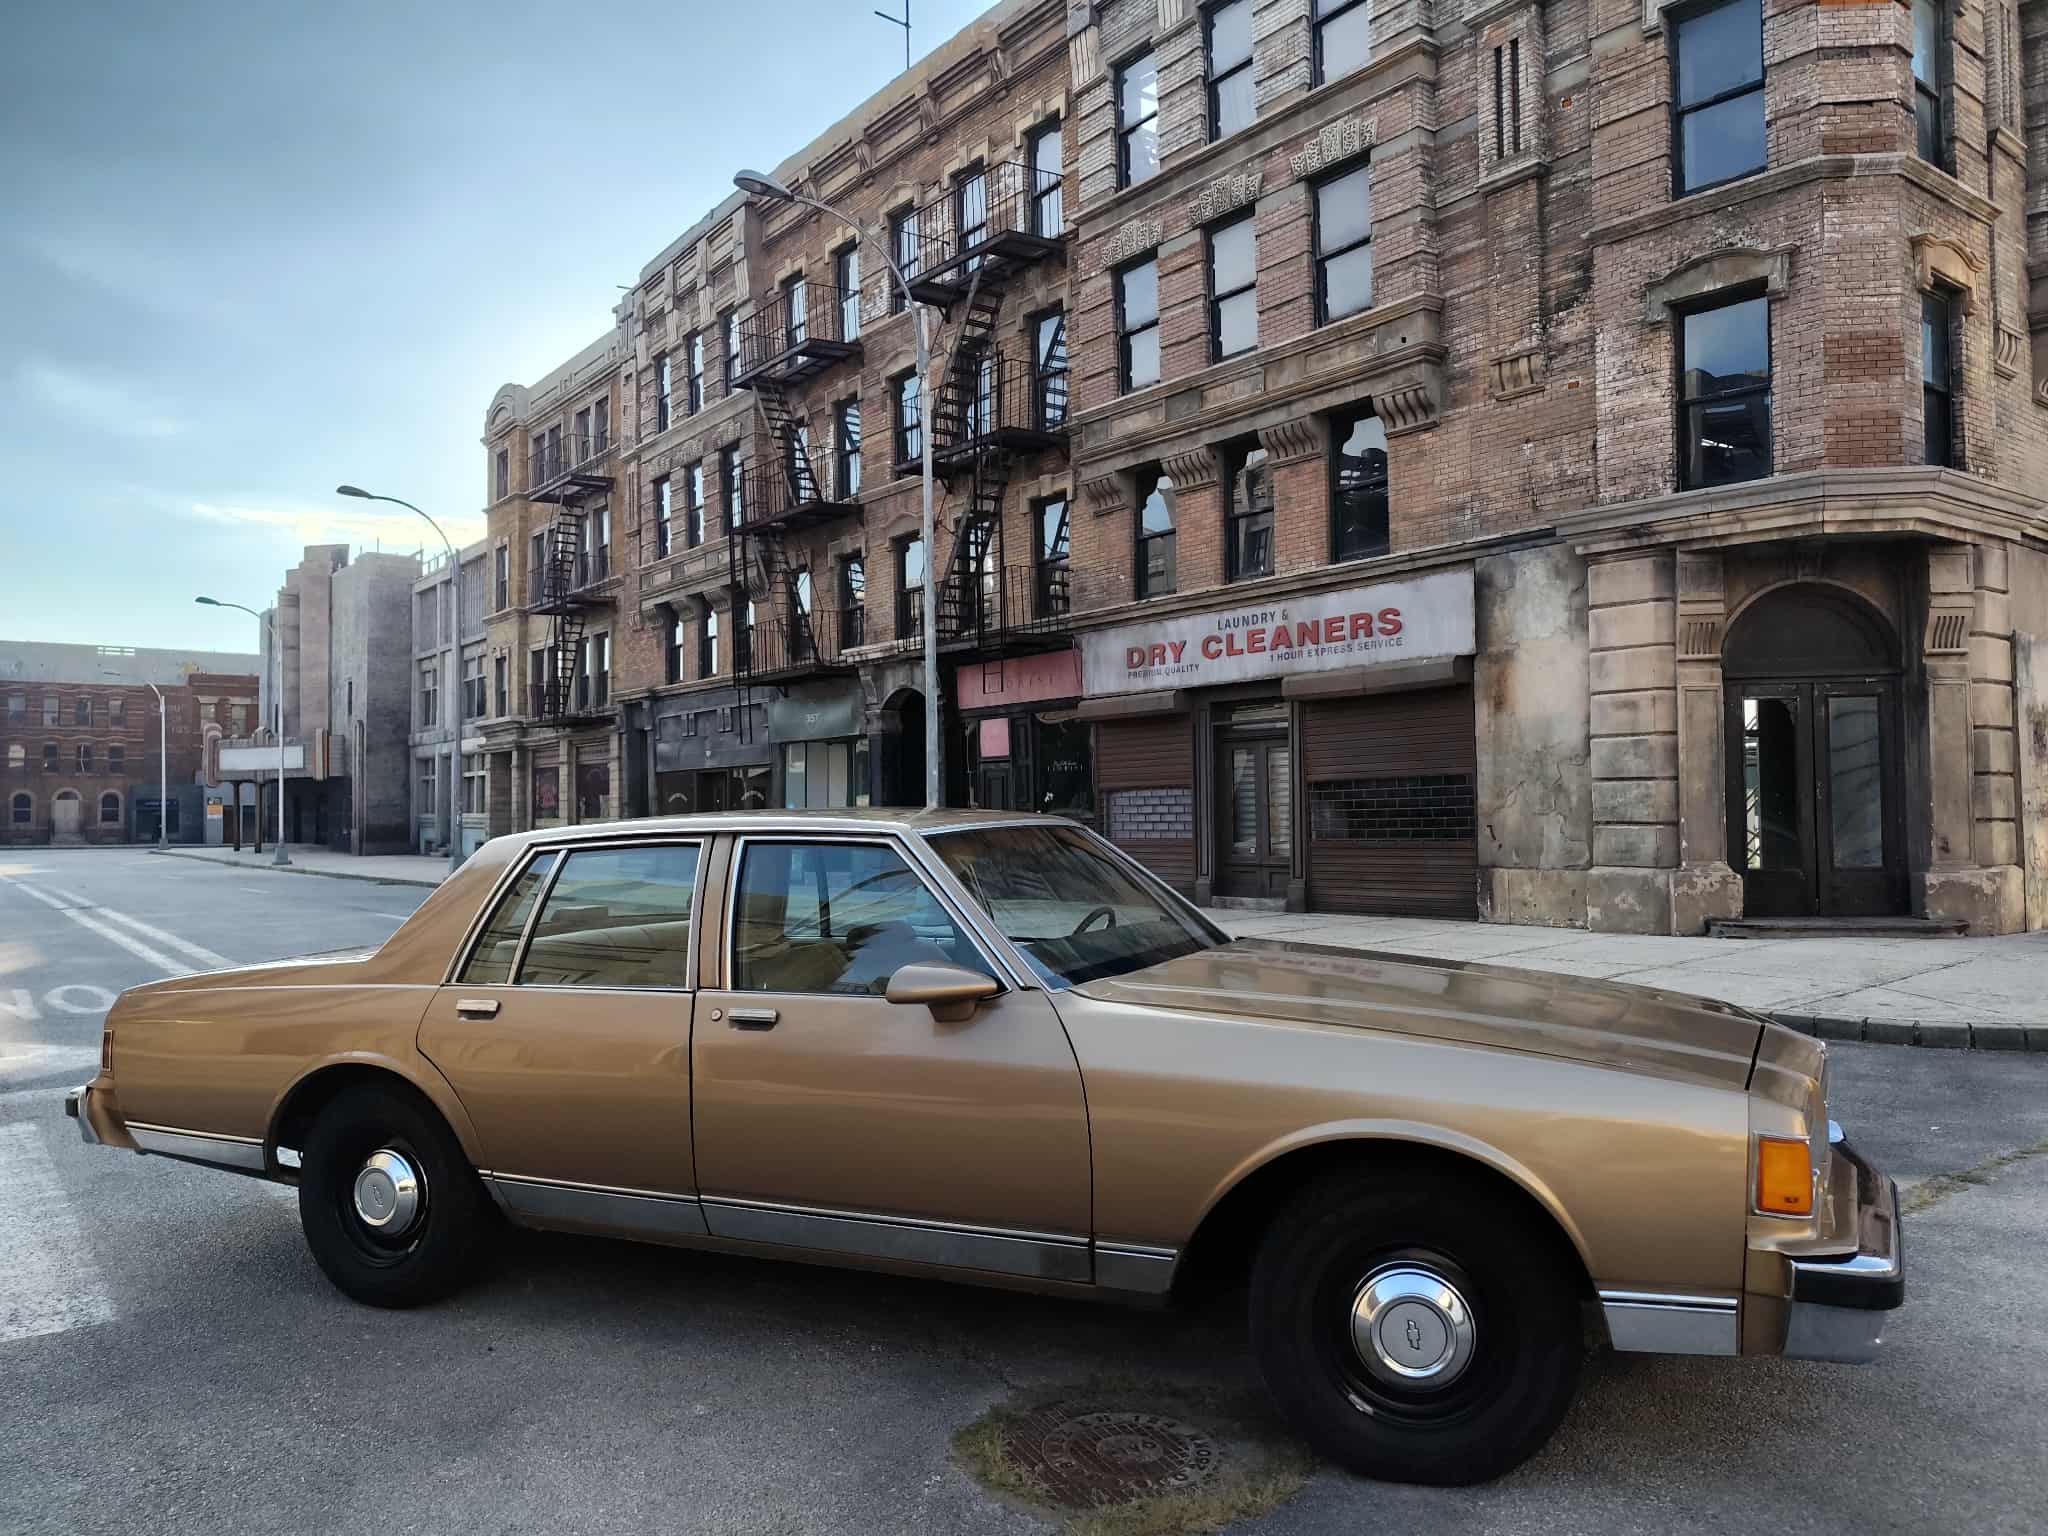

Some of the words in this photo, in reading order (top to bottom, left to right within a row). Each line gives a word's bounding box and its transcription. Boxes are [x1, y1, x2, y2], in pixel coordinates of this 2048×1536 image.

[1217, 611, 1276, 631] LAUNDRY
[1281, 608, 1289, 621] &
[1126, 639, 1188, 670] DRY
[1200, 607, 1404, 660] CLEANERS
[1277, 649, 1304, 663] HOUR
[1307, 643, 1353, 658] EXPRESS
[1357, 636, 1404, 652] SERVICE
[1127, 666, 1162, 680] PREMIUM
[1164, 663, 1200, 677] QUALITY
